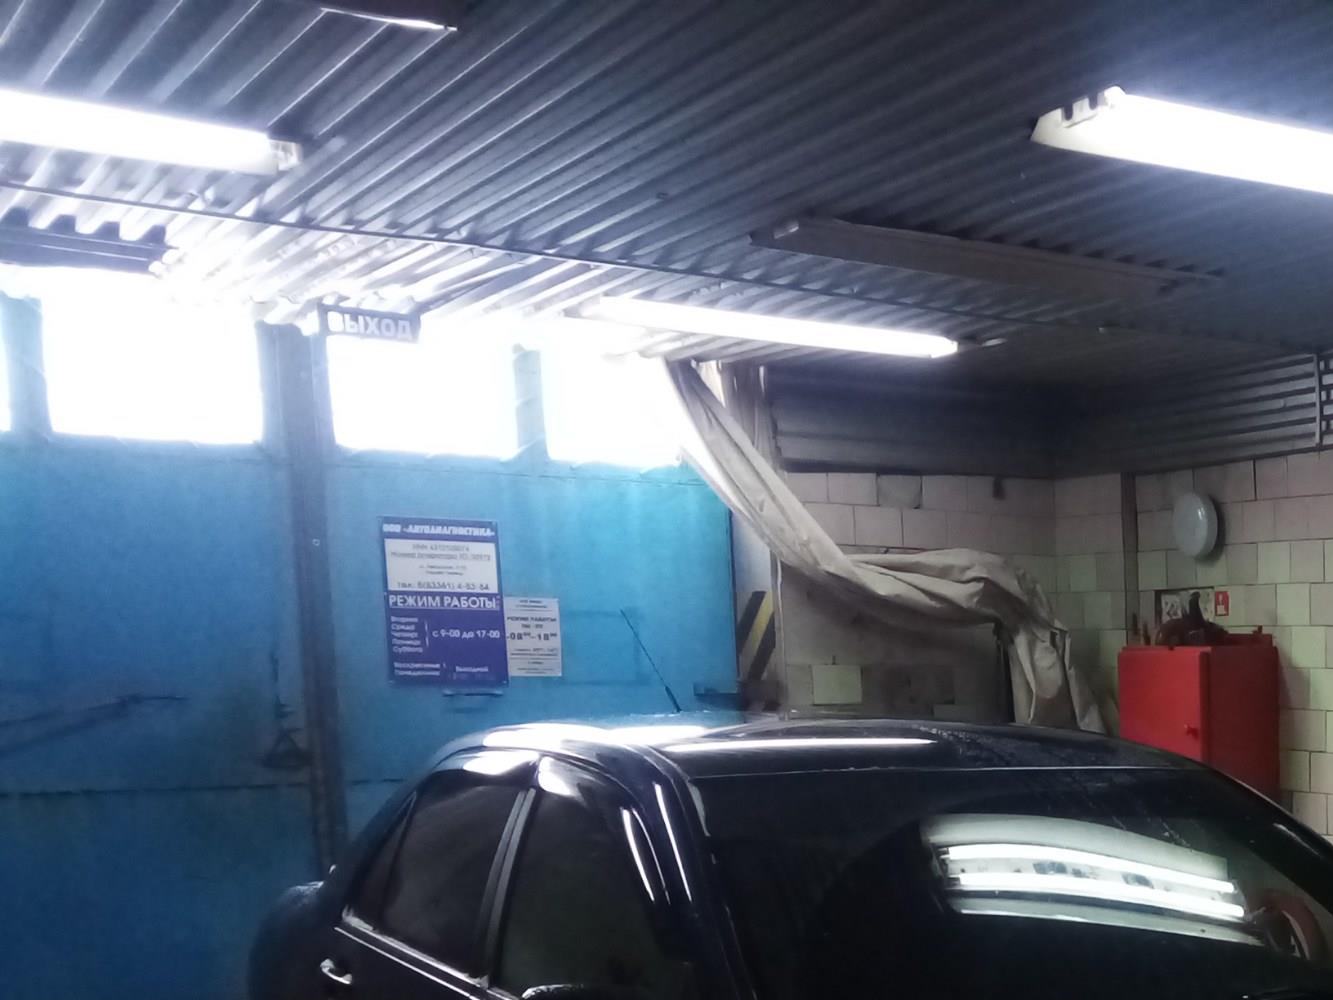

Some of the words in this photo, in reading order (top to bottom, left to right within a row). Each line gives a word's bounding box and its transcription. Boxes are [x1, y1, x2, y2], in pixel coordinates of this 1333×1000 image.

[327, 311, 413, 340] ВЫХОД
[388, 594, 441, 608] РЕЖИМ
[439, 628, 461, 638] 9-00
[461, 630, 475, 640] до
[475, 629, 501, 639] 17-00
